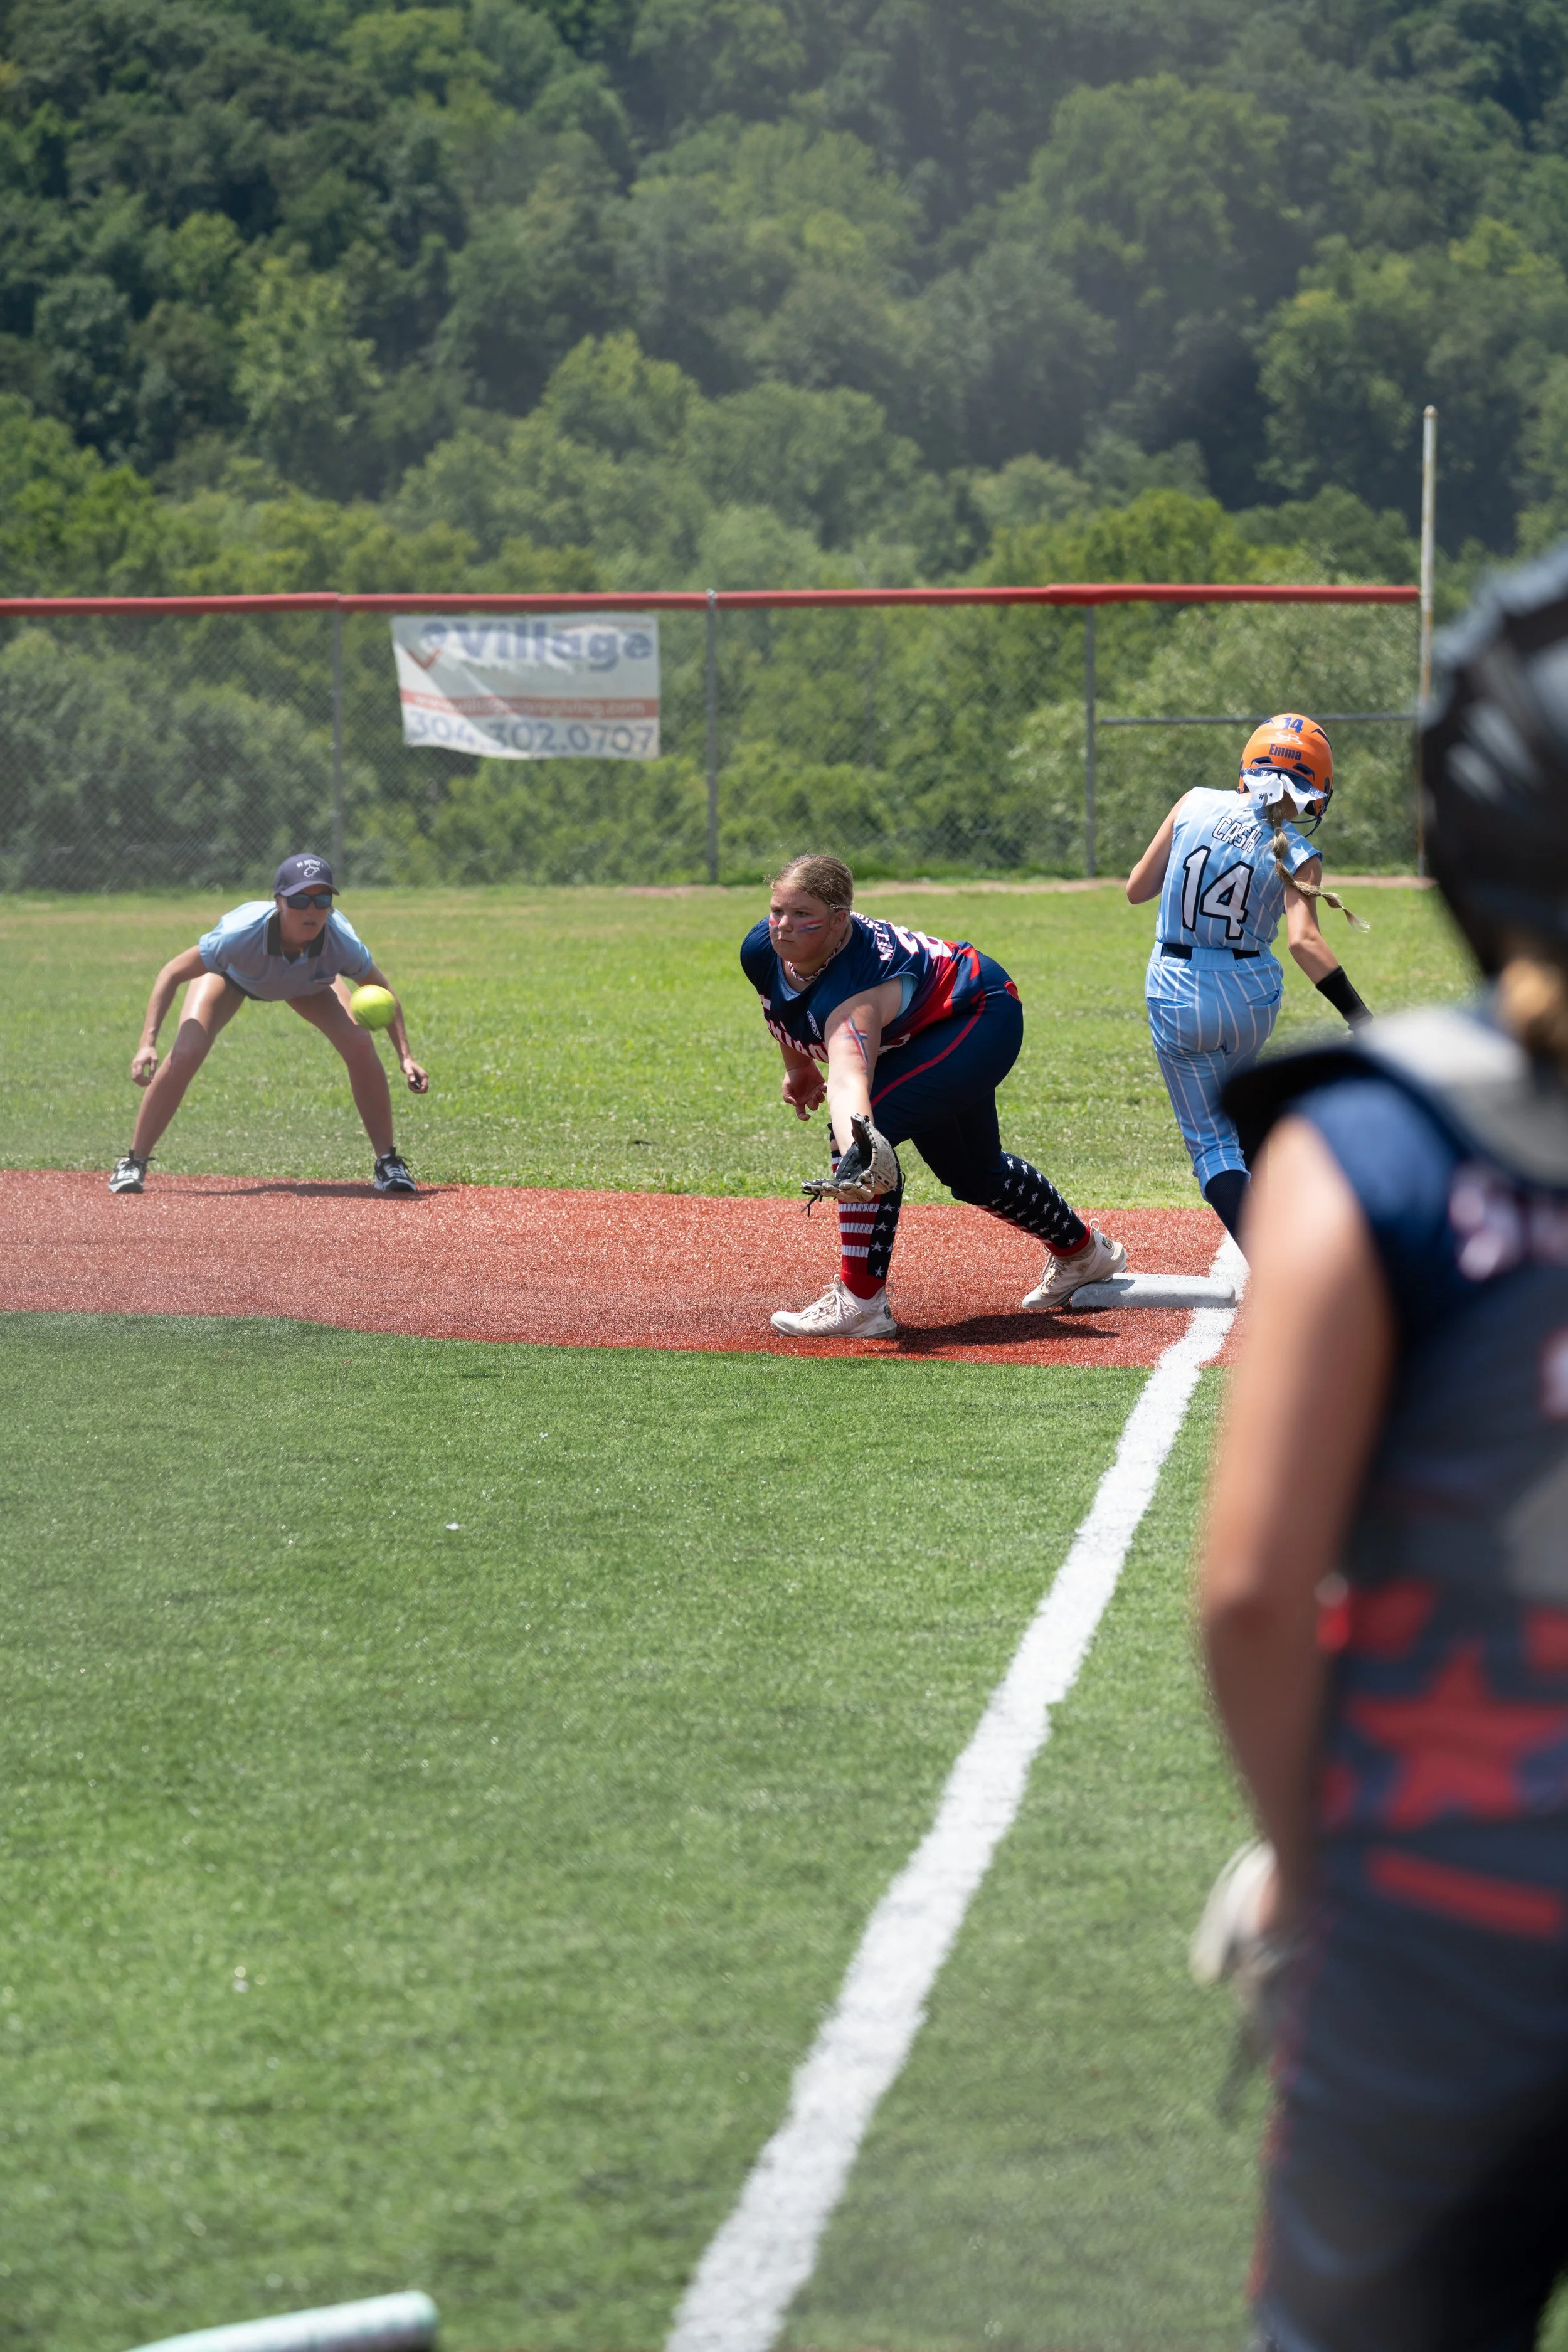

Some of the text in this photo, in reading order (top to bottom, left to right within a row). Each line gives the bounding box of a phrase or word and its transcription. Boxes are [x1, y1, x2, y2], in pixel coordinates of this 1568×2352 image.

[1283, 717, 1305, 734] 14
[1268, 744, 1303, 761] Emma
[1211, 816, 1264, 854] CASH
[1182, 845, 1254, 940] 14
